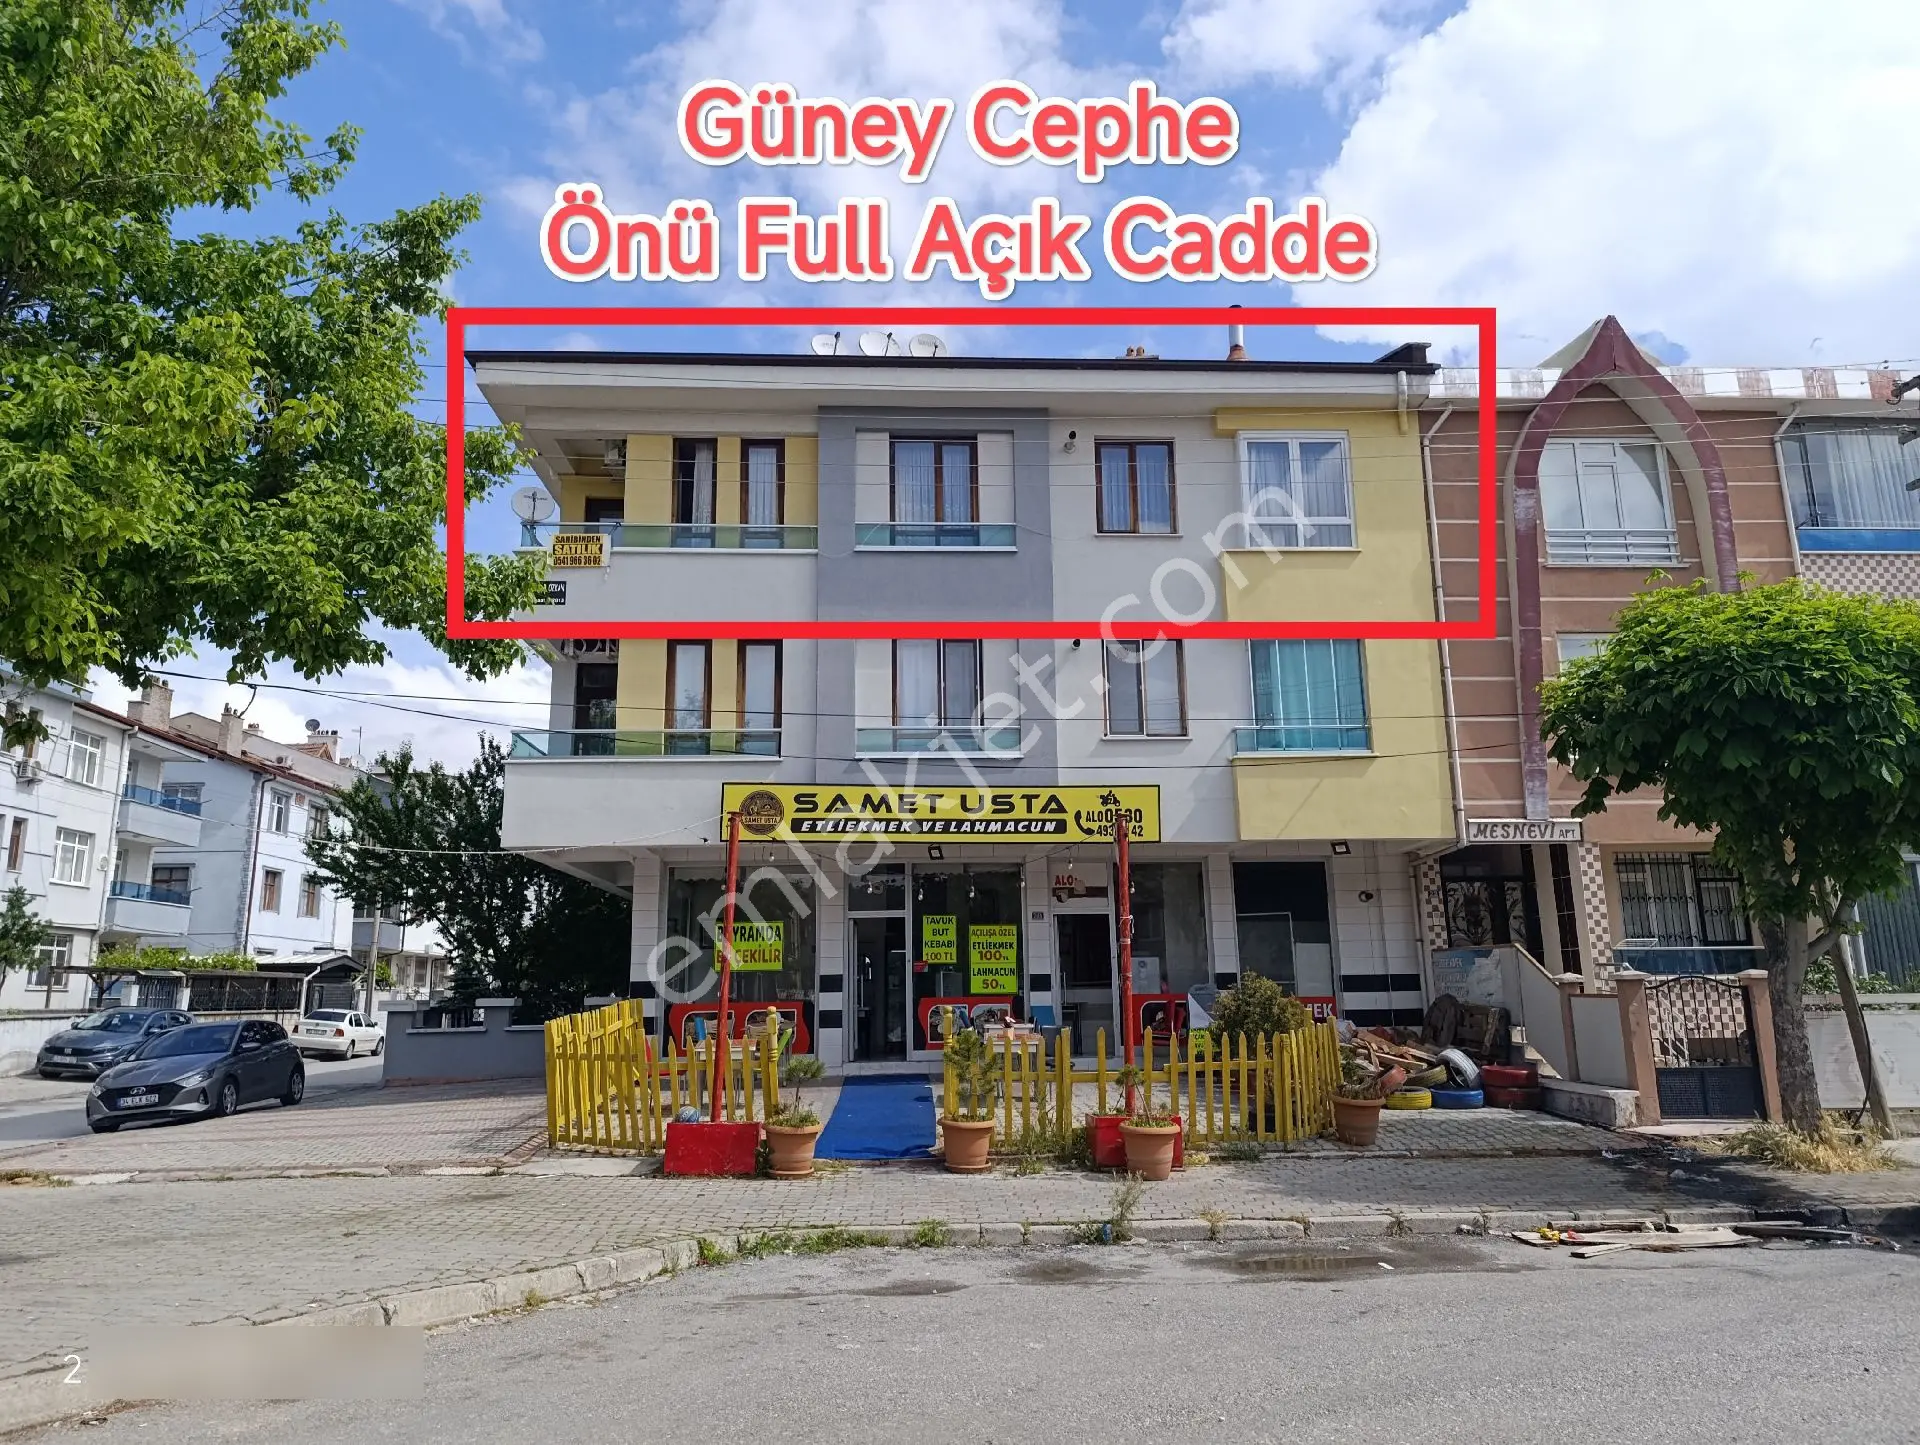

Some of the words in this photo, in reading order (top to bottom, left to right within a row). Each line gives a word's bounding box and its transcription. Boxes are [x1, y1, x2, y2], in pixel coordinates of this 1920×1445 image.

[554, 544, 601, 554] SATILIK
[793, 793, 944, 813] SAMET
[960, 793, 1068, 814] USTA
[1085, 810, 1104, 823] ALO
[800, 818, 913, 832] ETLİEKMEK
[922, 820, 944, 832] VE
[949, 821, 1057, 833] LAHMACUN
[926, 916, 954, 925] TAVUK
[717, 925, 782, 942] BYRAMDA
[932, 928, 949, 936] BUT
[925, 952, 941, 961] 100
[944, 952, 955, 961] TL
[972, 967, 1015, 977] LAHMACUN
